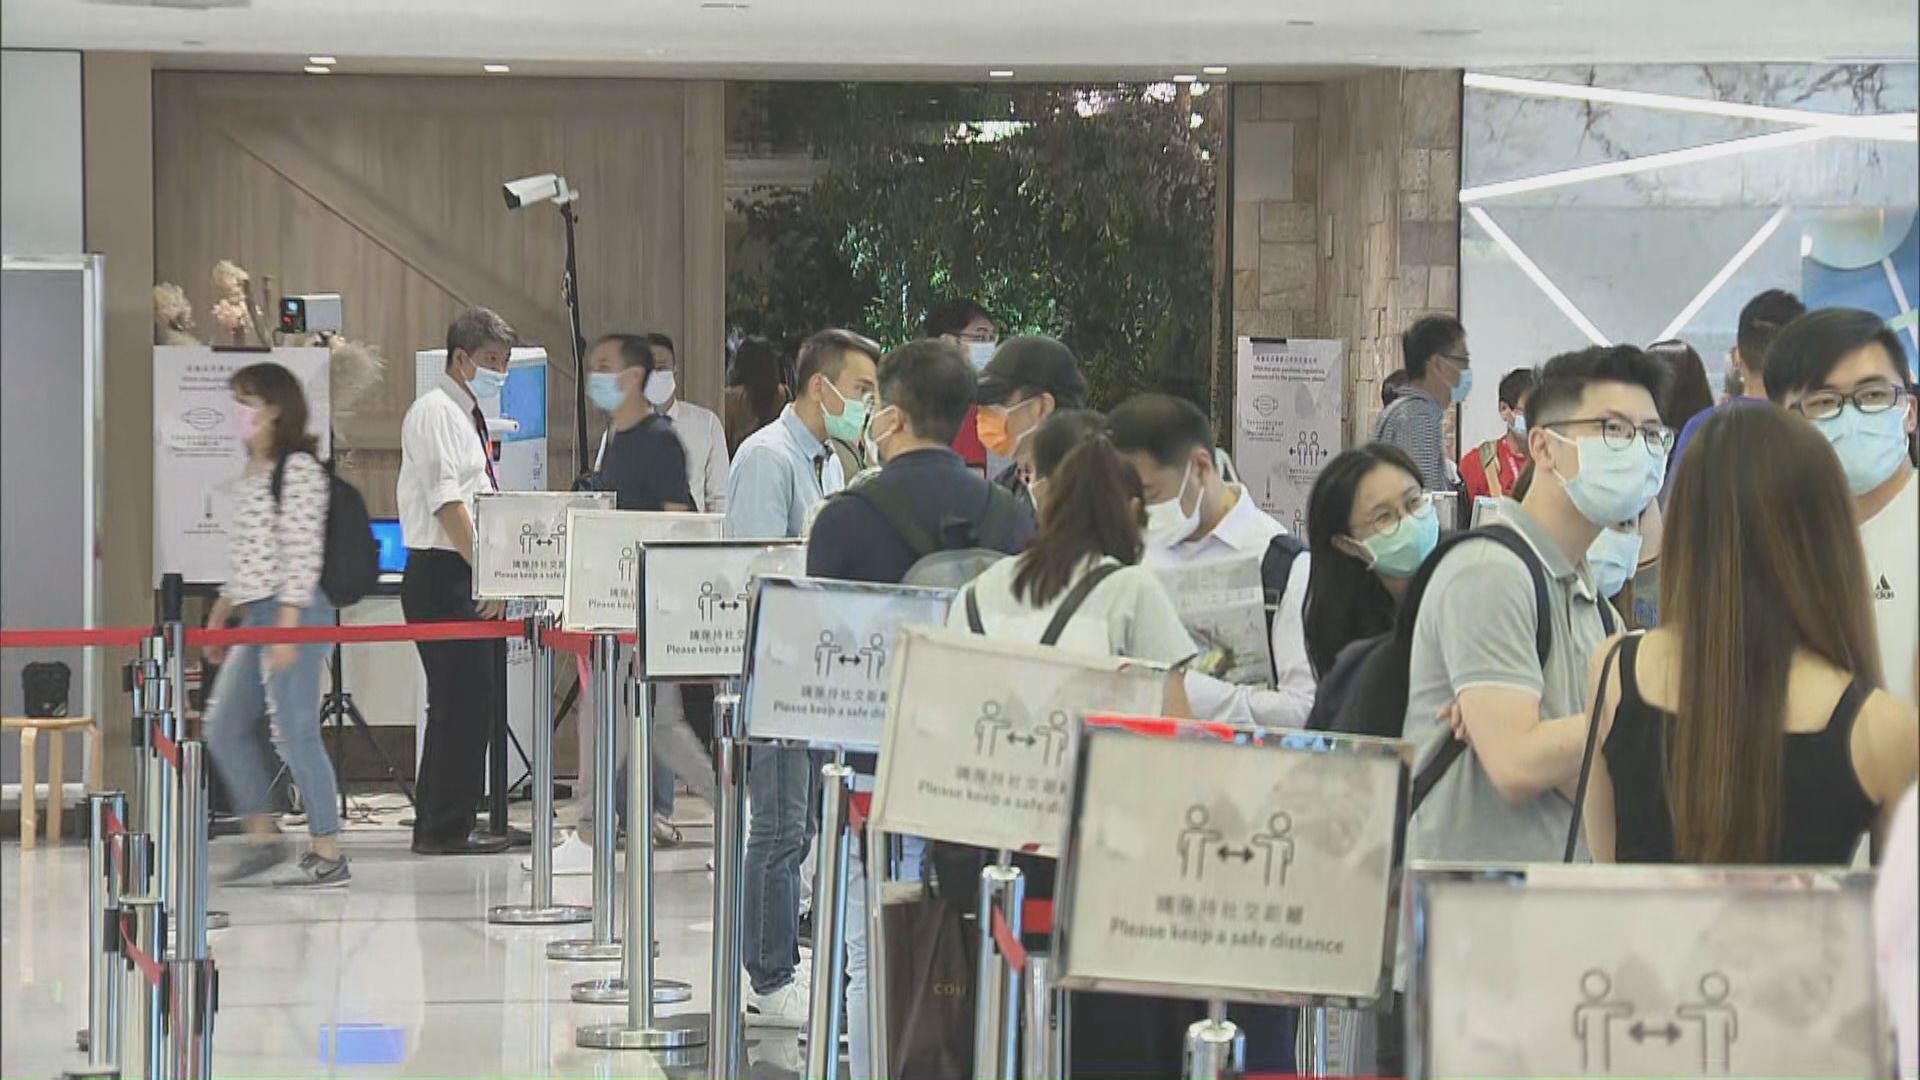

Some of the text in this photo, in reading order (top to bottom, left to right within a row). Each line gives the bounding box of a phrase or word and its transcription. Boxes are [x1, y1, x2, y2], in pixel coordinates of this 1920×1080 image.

[494, 570, 519, 578] Please
[519, 570, 538, 580] keep
[588, 598, 616, 609] Please
[666, 643, 697, 655] Please
[699, 643, 722, 657] keep
[773, 700, 807, 713] Please
[810, 703, 836, 717] keep
[847, 706, 868, 717] safe
[917, 779, 962, 799] Please
[967, 788, 1000, 808] keep
[1003, 795, 1013, 807] a
[1015, 796, 1043, 811] safe
[1109, 915, 1344, 955] Please keep a safe distance
